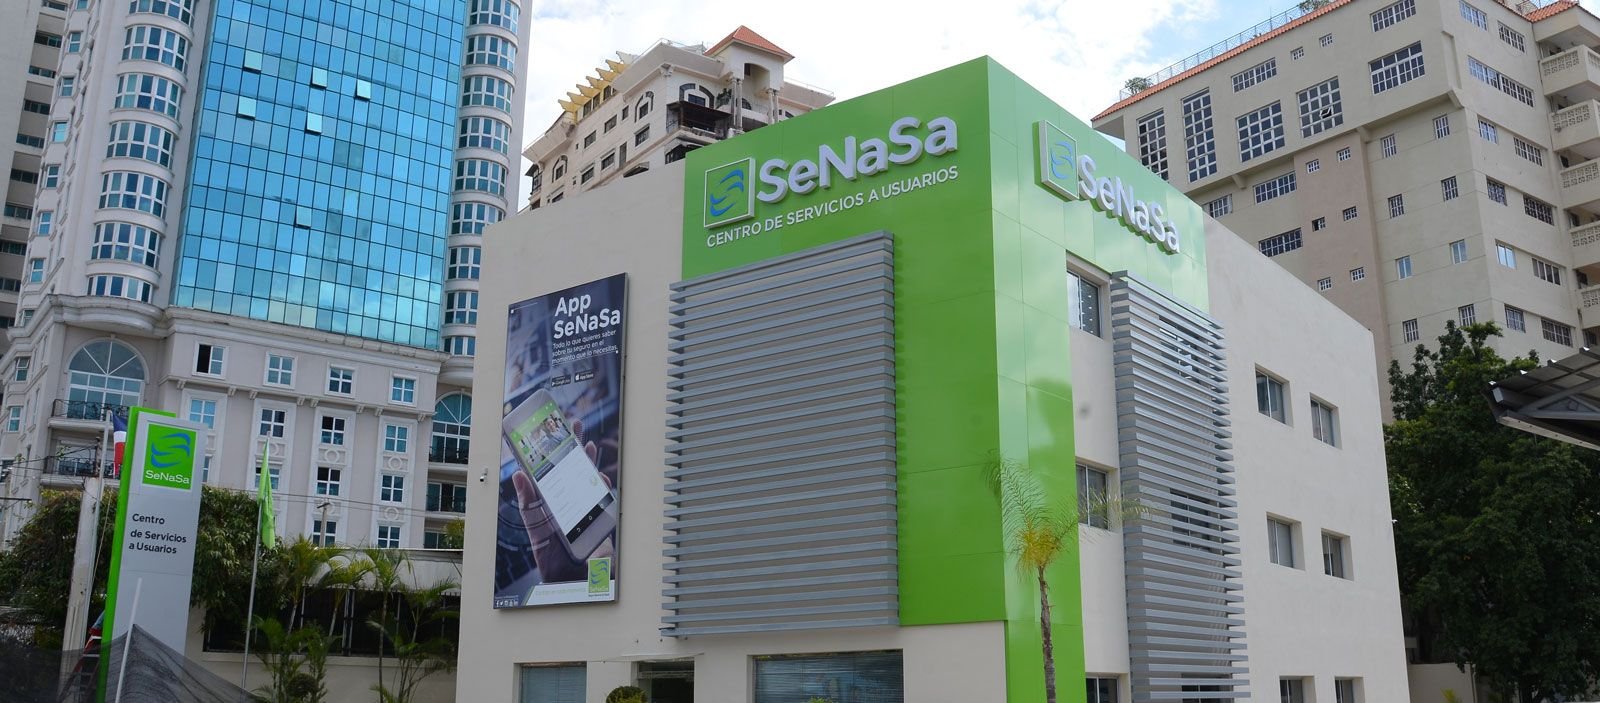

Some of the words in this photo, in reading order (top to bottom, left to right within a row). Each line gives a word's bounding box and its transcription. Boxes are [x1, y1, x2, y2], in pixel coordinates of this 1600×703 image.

[757, 116, 958, 204] SeNaSa
[707, 222, 762, 247] CENTRO
[764, 215, 783, 231] DE
[786, 192, 864, 226] SERVICIOS
[868, 188, 879, 203] A
[881, 166, 959, 199] USUARIOS
[1078, 154, 1180, 254] SeNaSa
[554, 294, 591, 317] App
[553, 308, 620, 339] SeNaSa
[582, 334, 601, 343] quieres
[601, 329, 616, 338] saber
[551, 349, 566, 357] sobre
[573, 344, 591, 352] seguro
[551, 354, 576, 364] momento
[576, 352, 586, 360] que
[145, 469, 190, 485] SeNaSa
[132, 513, 165, 525] Centro
[130, 529, 142, 538] de
[145, 530, 187, 543] Servicios
[136, 542, 177, 554] Usuarios
